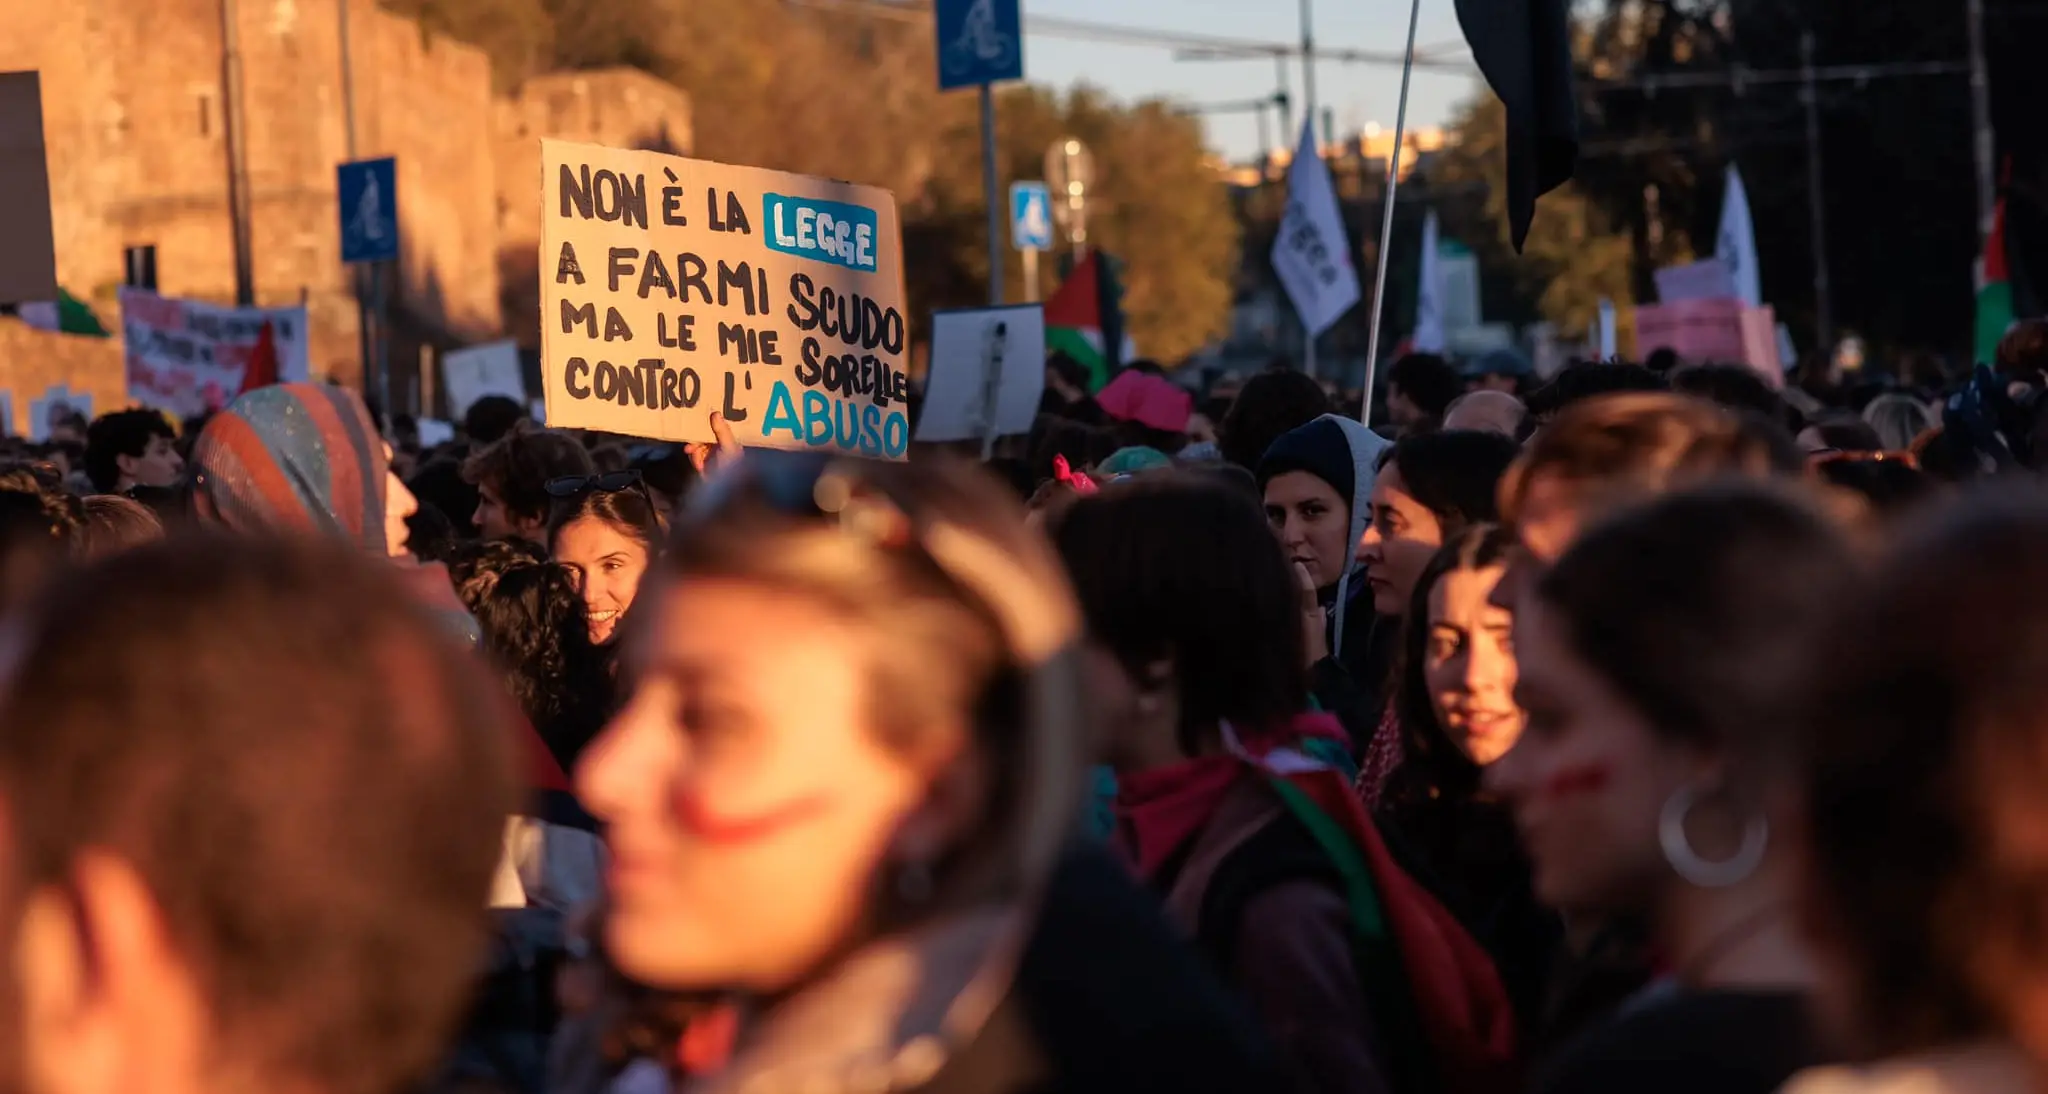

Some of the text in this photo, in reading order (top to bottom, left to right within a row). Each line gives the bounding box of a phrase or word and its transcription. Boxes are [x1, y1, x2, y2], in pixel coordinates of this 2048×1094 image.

[560, 163, 875, 266] NON È LA LEGGE
[556, 241, 904, 355] A FARMI SCUDO
[560, 298, 909, 408] MA LE MIE SORELLE
[564, 357, 701, 410] CONTRO
[762, 380, 908, 458] ABUSO
